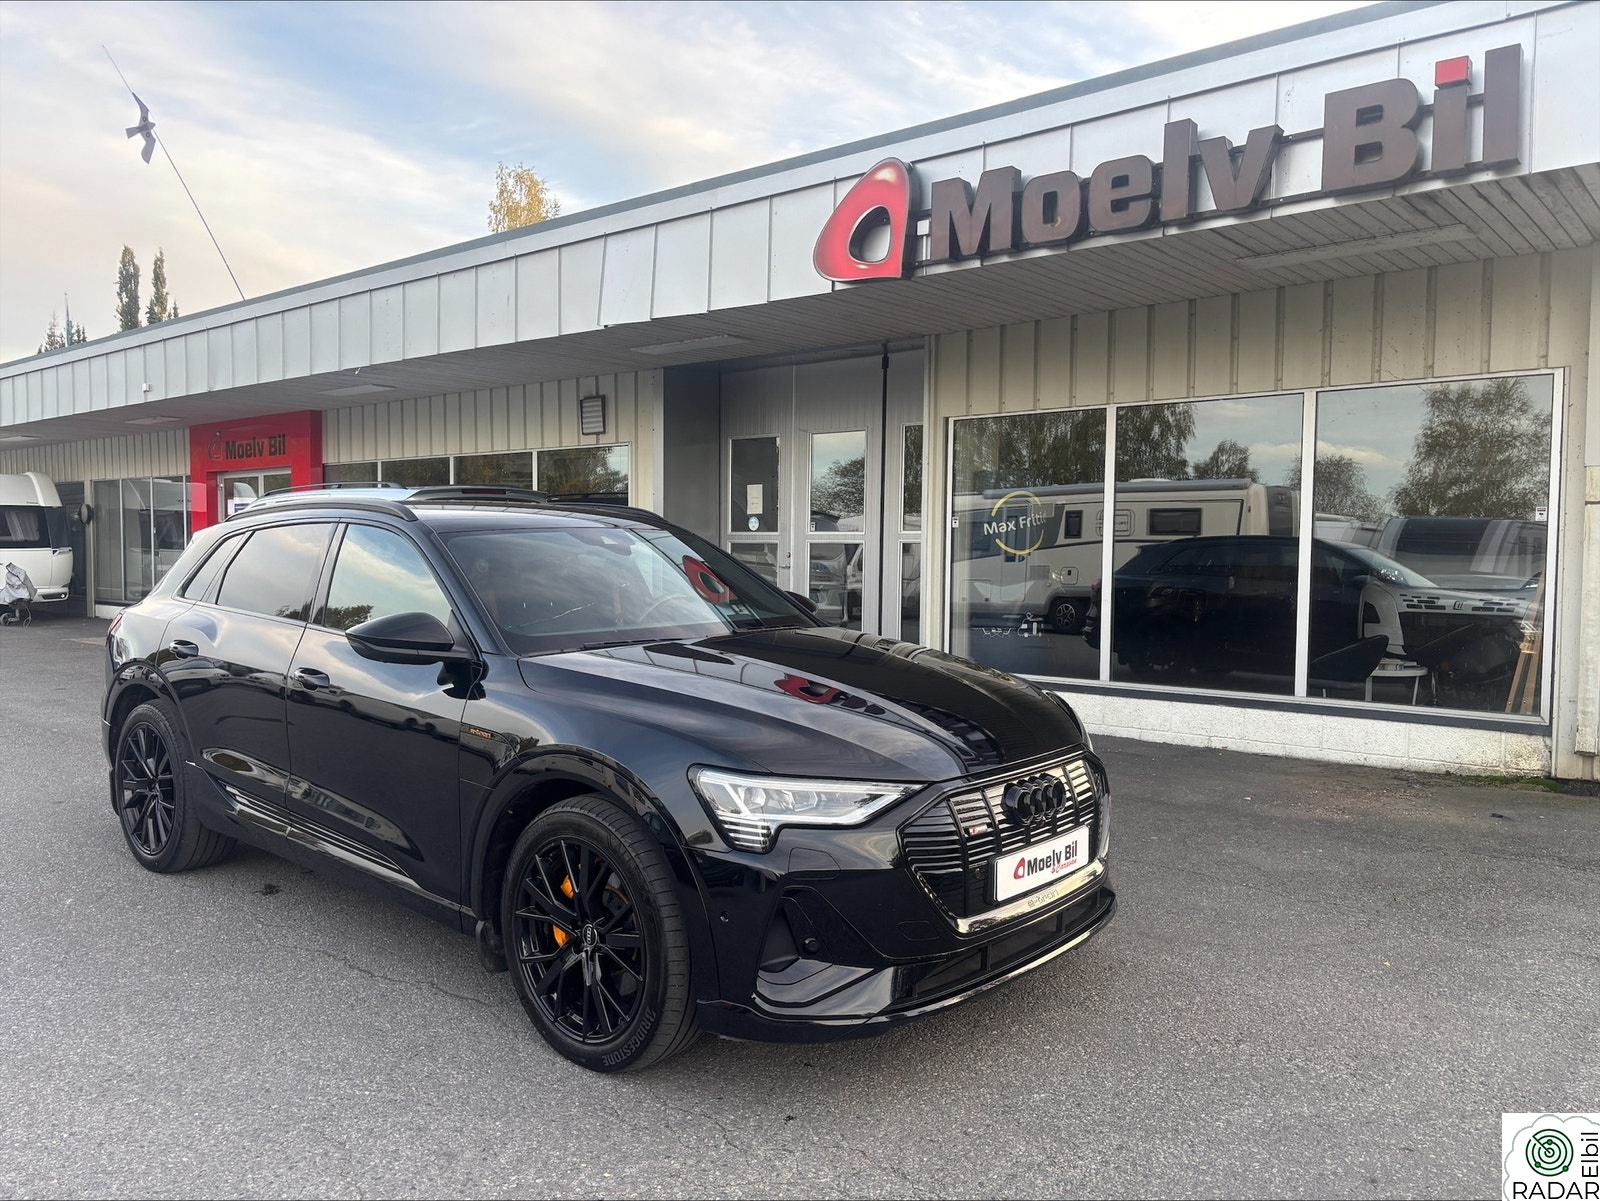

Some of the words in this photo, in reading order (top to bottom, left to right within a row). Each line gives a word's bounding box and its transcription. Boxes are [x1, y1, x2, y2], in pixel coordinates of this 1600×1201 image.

[930, 117, 1284, 262] Moelv
[1323, 43, 1524, 195] Bil
[225, 437, 265, 460] Moelv
[268, 433, 286, 456] Bil
[983, 520, 1017, 536] Max
[1026, 849, 1063, 876] Moelv
[1064, 840, 1078, 861] Bil
[601, 1005, 657, 1067] BRIDGESTONE
